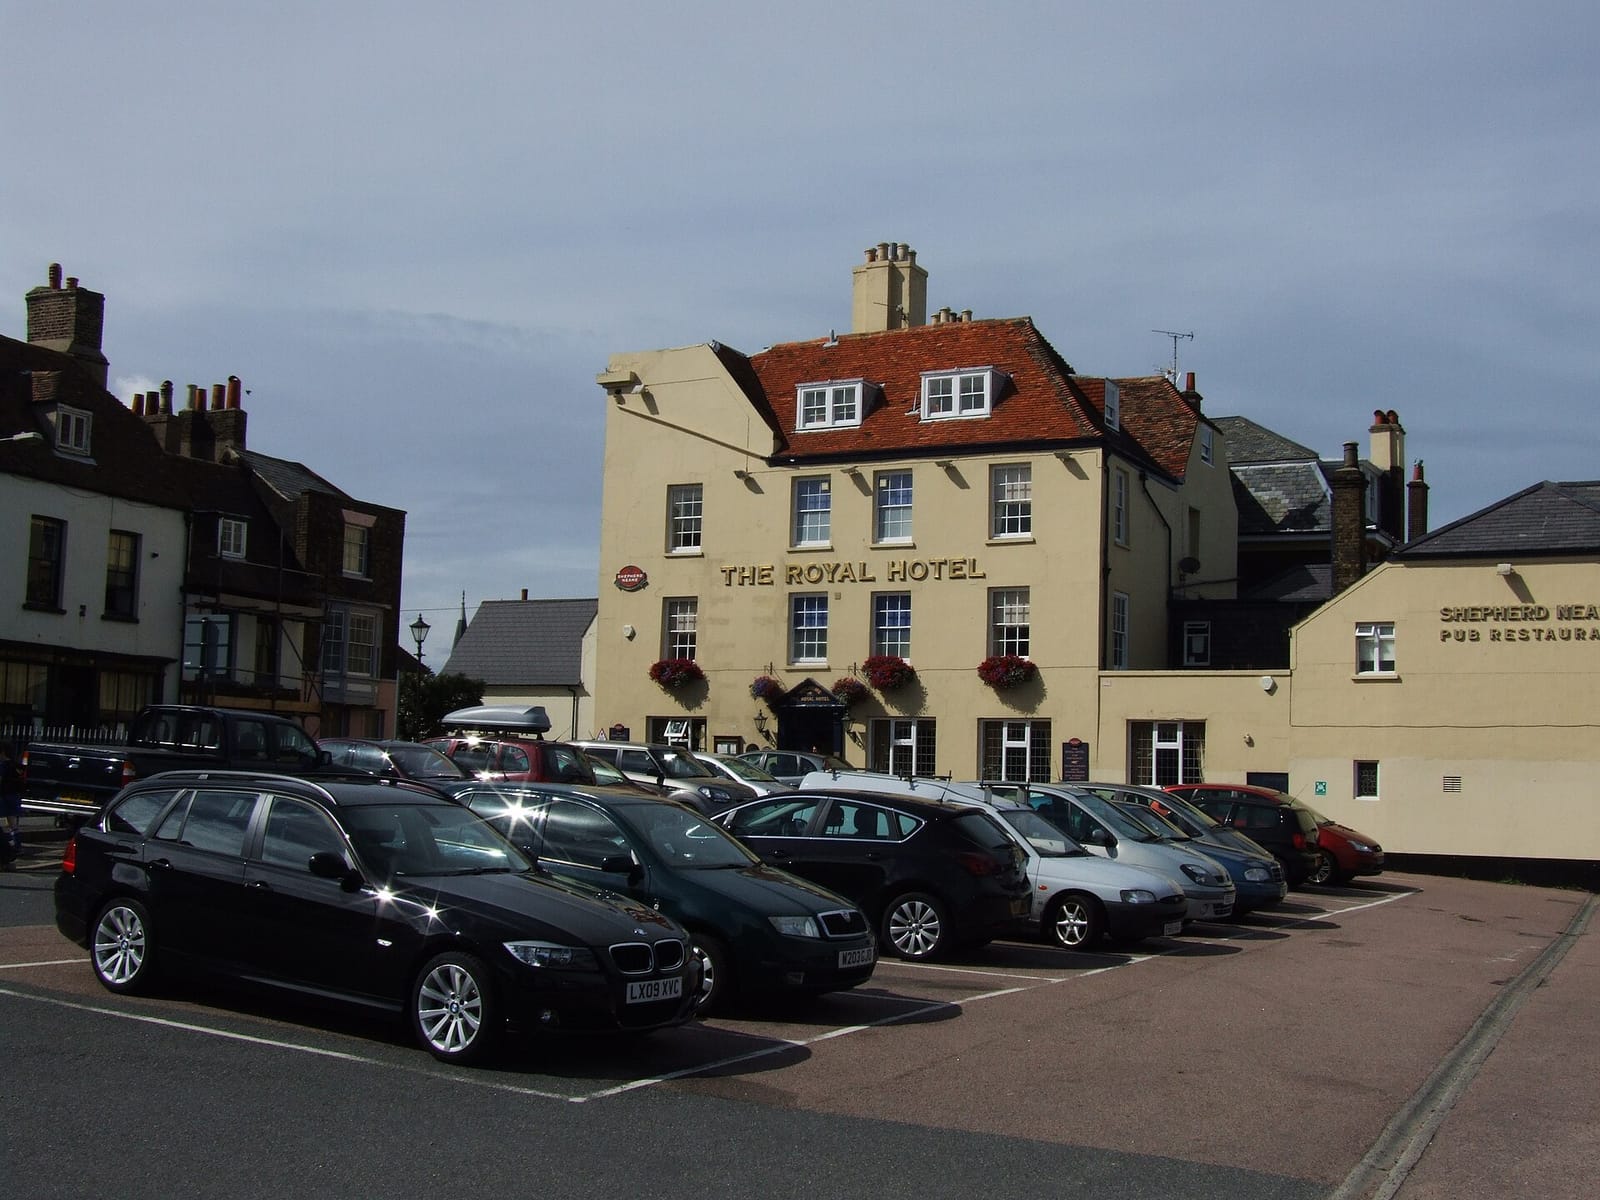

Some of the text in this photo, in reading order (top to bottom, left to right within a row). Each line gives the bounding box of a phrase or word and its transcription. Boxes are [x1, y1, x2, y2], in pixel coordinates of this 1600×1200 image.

[720, 557, 986, 586] THE ROYAL HOTEL
[1440, 605, 1550, 623] SHEPHERD
[1440, 628, 1481, 642] PUB
[630, 982, 660, 1000] LX09
